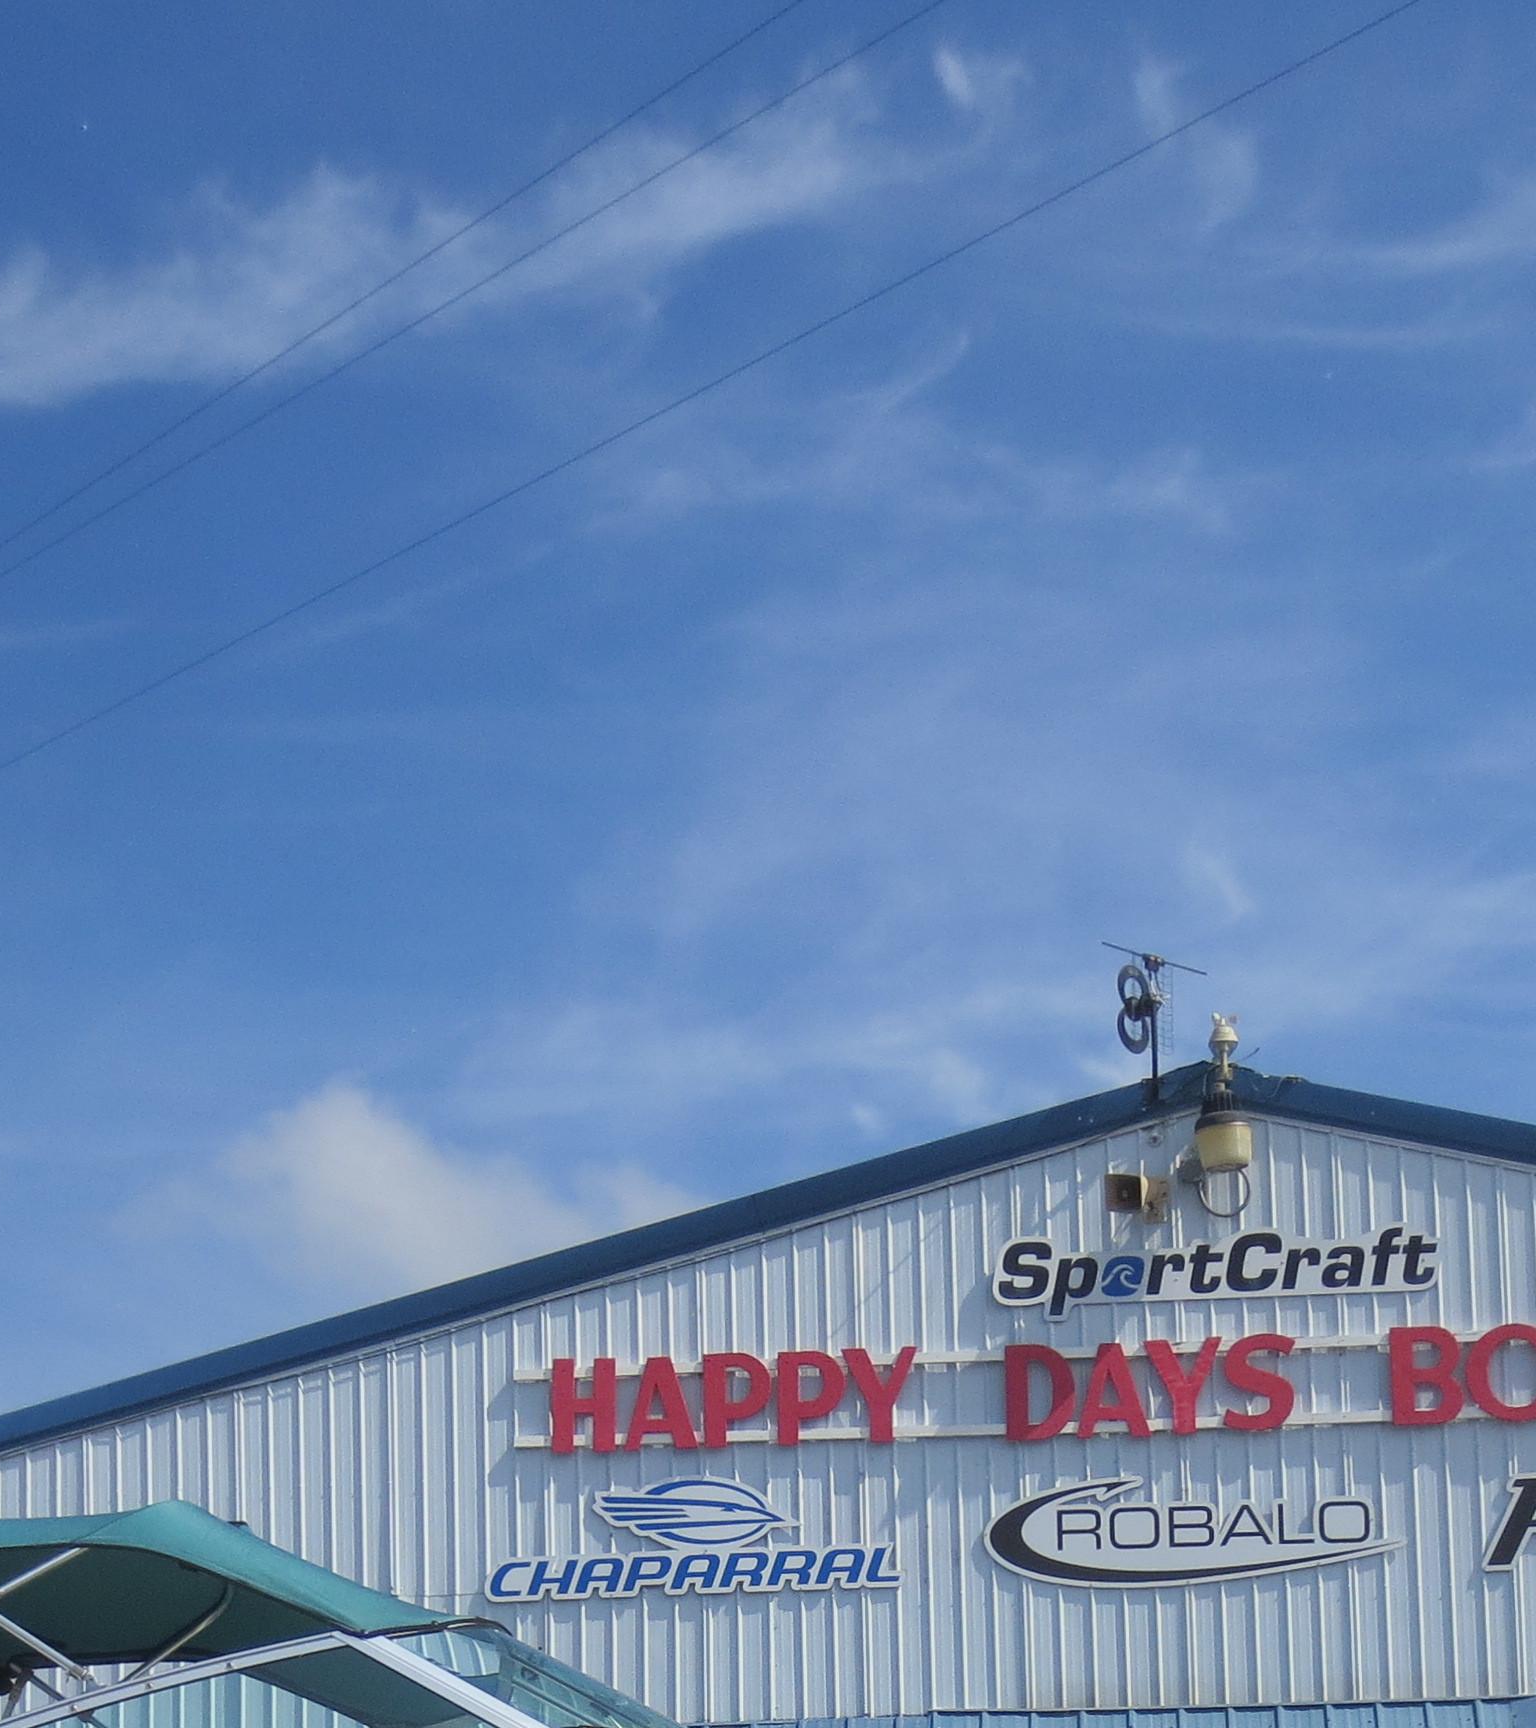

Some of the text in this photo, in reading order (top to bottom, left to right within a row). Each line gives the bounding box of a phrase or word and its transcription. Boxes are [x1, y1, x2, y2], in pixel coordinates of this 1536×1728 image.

[998, 1226, 1438, 1316] SportCraft
[551, 1346, 917, 1453] HAPPY
[1004, 1334, 1296, 1442] DAYS
[1056, 1500, 1370, 1551] ROBALO
[489, 1546, 901, 1600] CHAPARRAL
